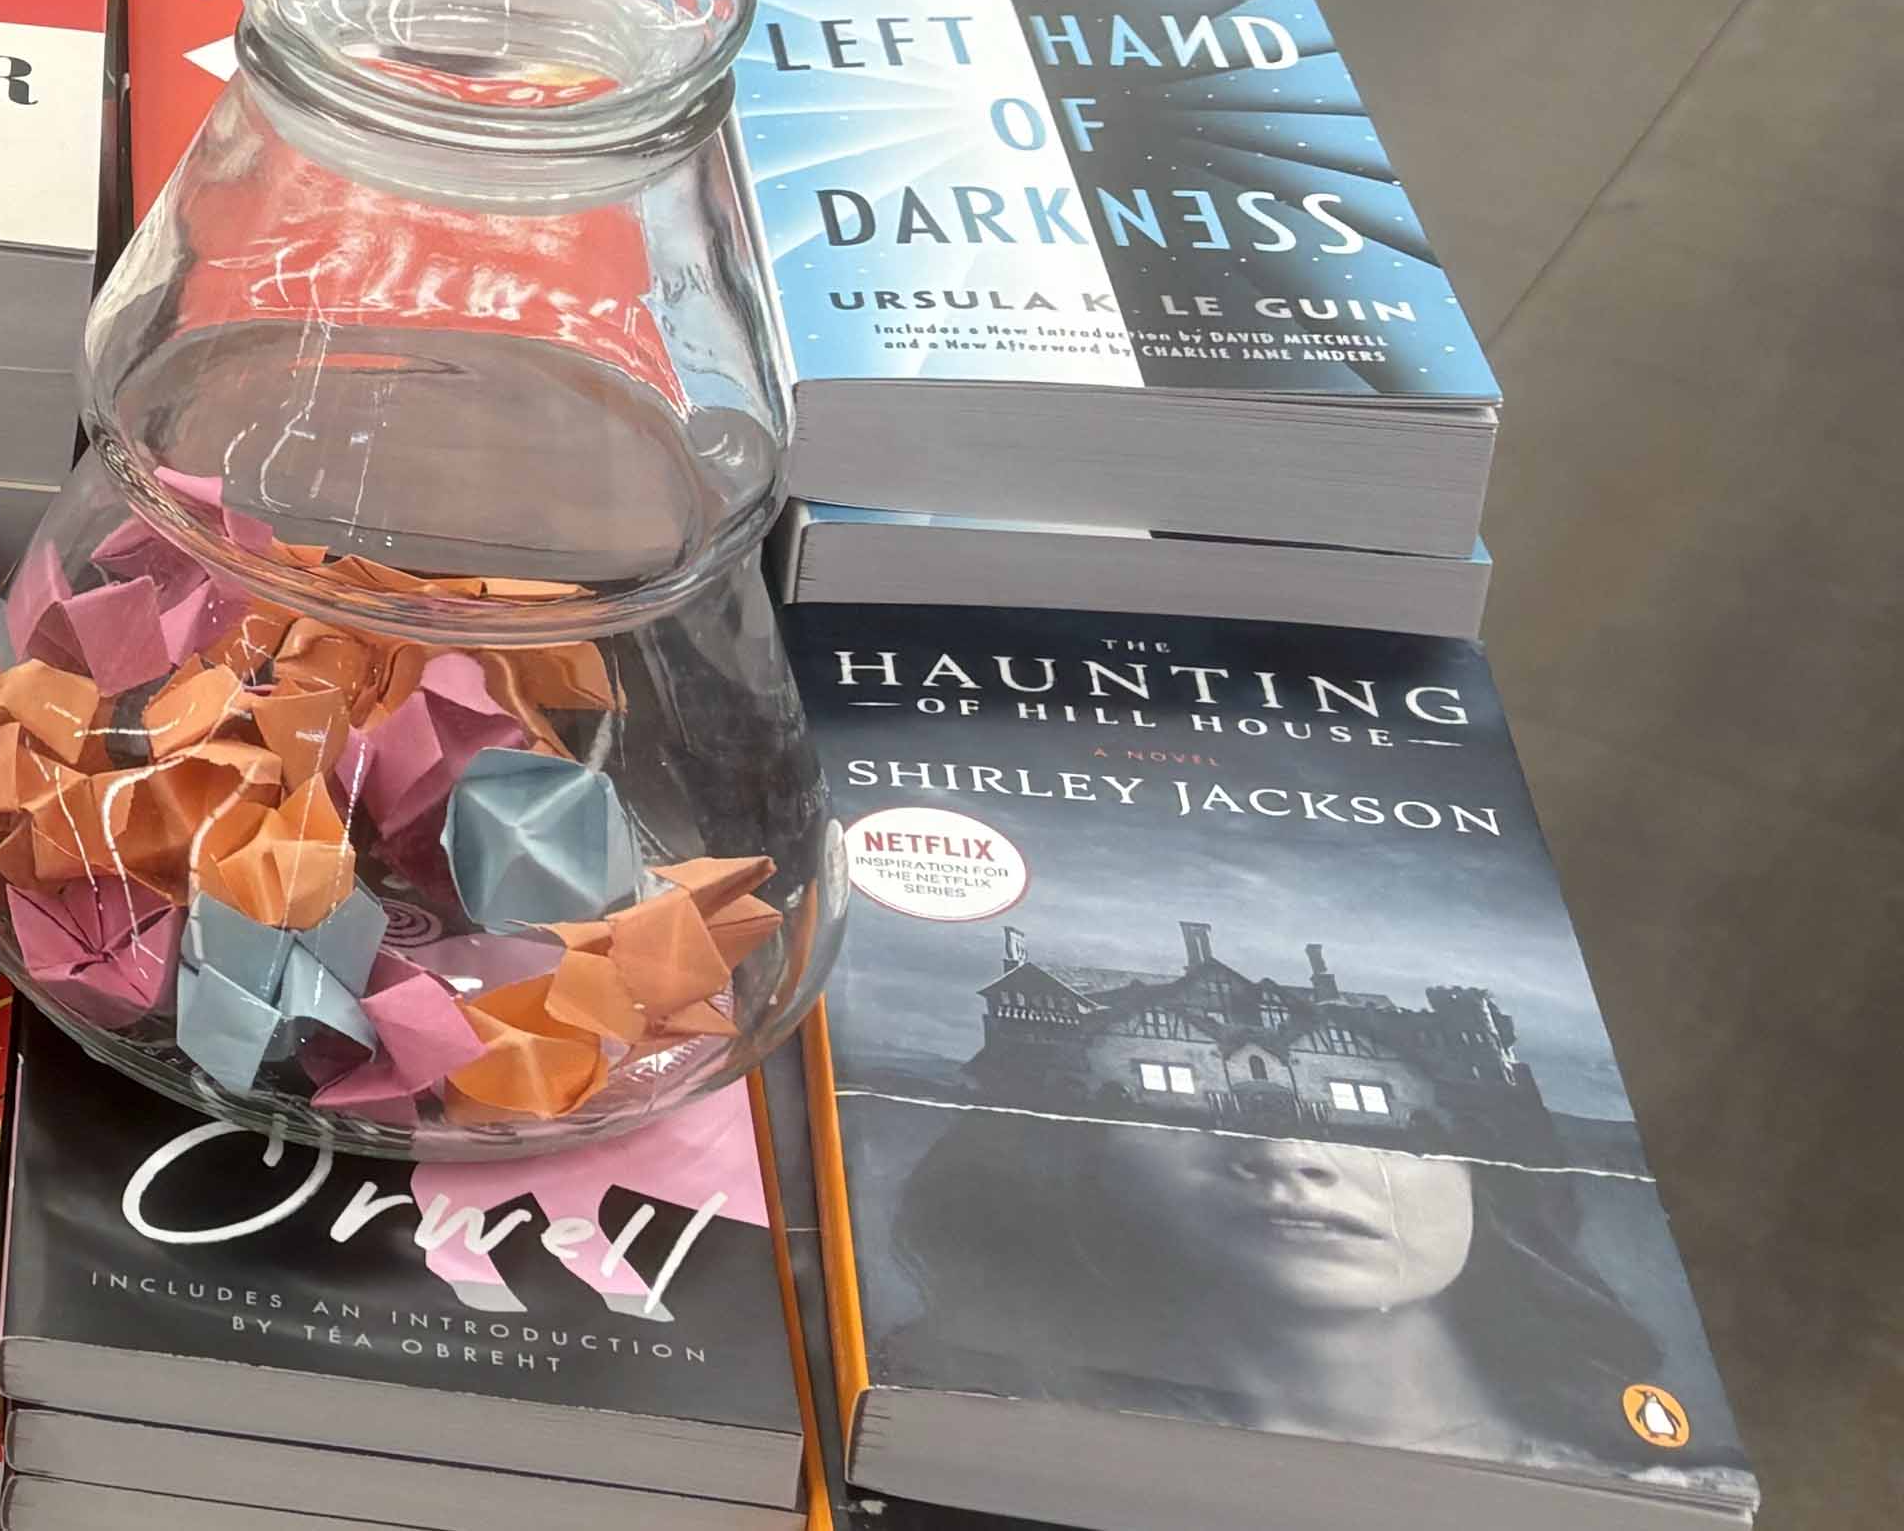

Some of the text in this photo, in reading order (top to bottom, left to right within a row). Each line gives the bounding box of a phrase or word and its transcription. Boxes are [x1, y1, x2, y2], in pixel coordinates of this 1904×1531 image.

[766, 15, 1300, 70] LEFT HAND
[990, 97, 1105, 152] OF
[817, 186, 1365, 255] DARKNESS
[830, 290, 1057, 312] URSULA
[1160, 295, 1224, 317] LE
[1255, 297, 1418, 324] GUIN
[874, 322, 1389, 347] Includes by DAVID MITCHELL
[883, 338, 1387, 363] and Afterword CHARLIE JANE ANDERS
[1101, 639, 1172, 653] THE
[836, 650, 1470, 726] HAUNTING
[916, 697, 1394, 747] OF HILL HOUSE
[1128, 750, 1222, 766] NOVEL
[848, 760, 1504, 838] SHIRLEY JACKSON
[855, 856, 1009, 878] INSPIRATION FOR
[864, 831, 995, 862] NETFLIX
[876, 869, 992, 888] THE NETFLIX
[903, 884, 967, 898] SERIES
[122, 1115, 729, 1315] Orwell
[90, 1272, 710, 1364] INCLUDES AN INTRODUCTION
[232, 1315, 564, 1375] BY TÉA OBREHT
